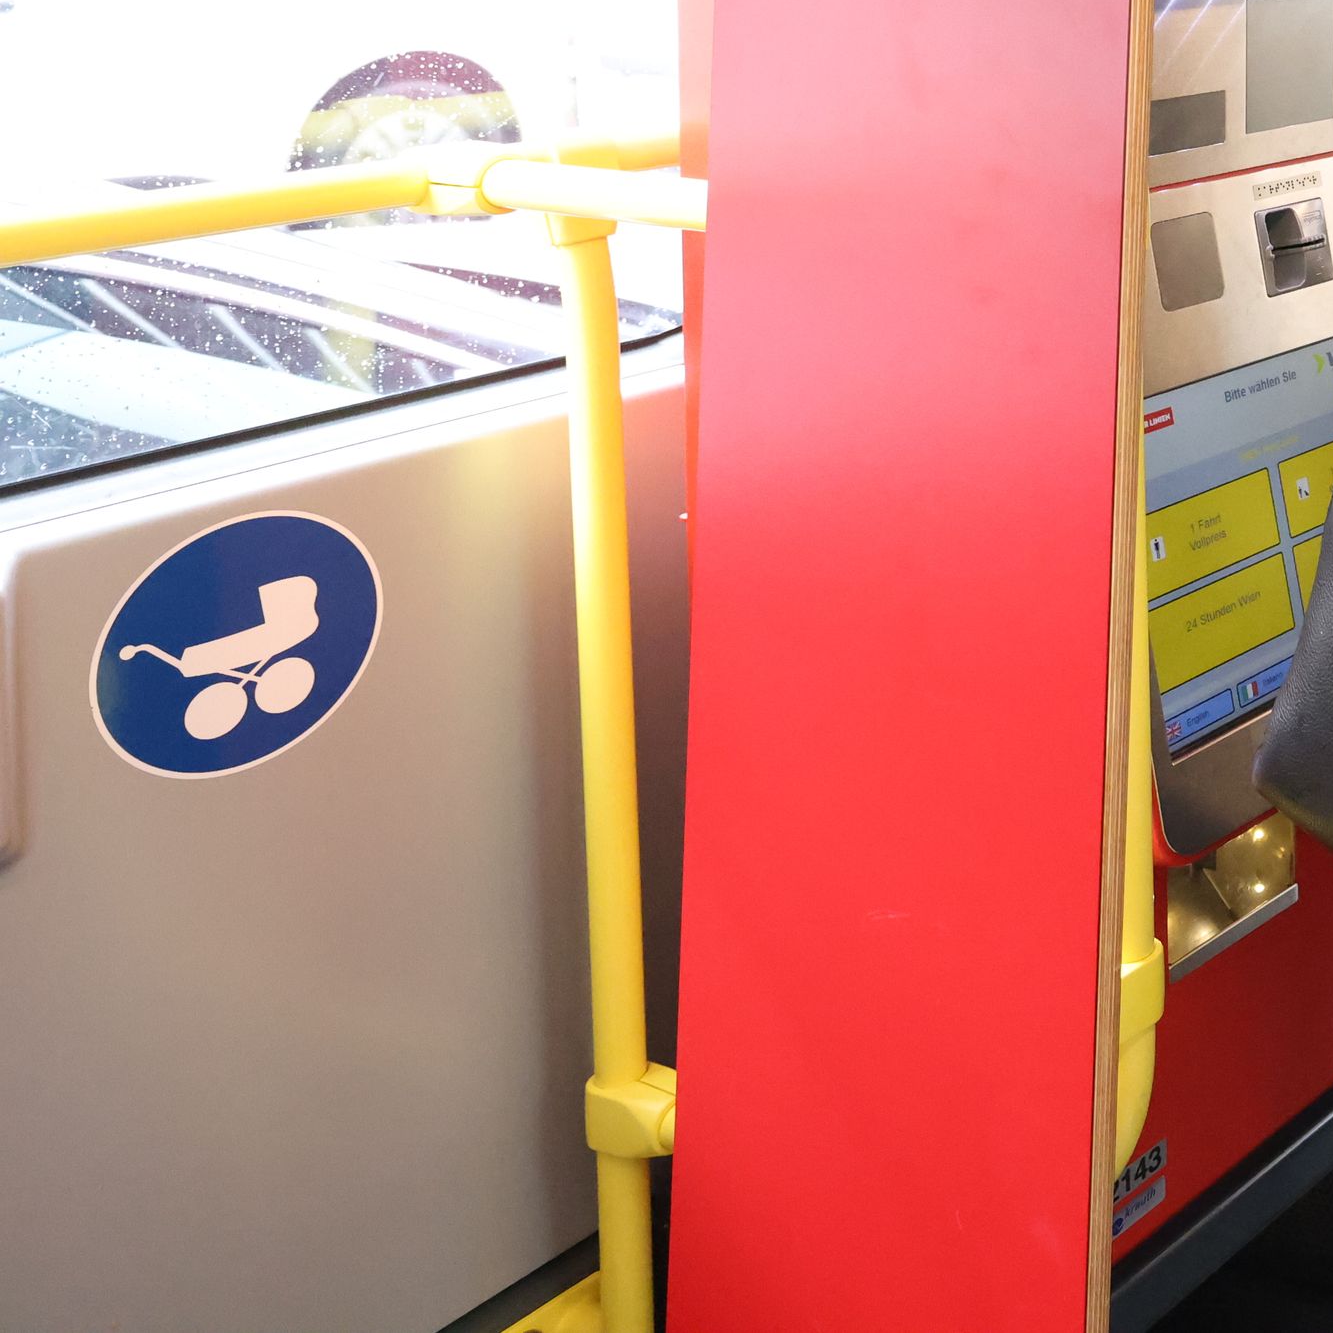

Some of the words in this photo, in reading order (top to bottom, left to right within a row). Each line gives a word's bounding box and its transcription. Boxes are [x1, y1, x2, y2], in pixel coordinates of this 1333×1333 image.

[1224, 387, 1247, 403] Bitte
[1248, 376, 1280, 394] wählen
[1282, 370, 1297, 383] Sie
[1198, 514, 1221, 531] Fahrt
[1189, 530, 1227, 551] Vollpreis
[1186, 618, 1197, 633] 24
[1200, 602, 1237, 626] Stunden
[1238, 591, 1261, 607] Wien
